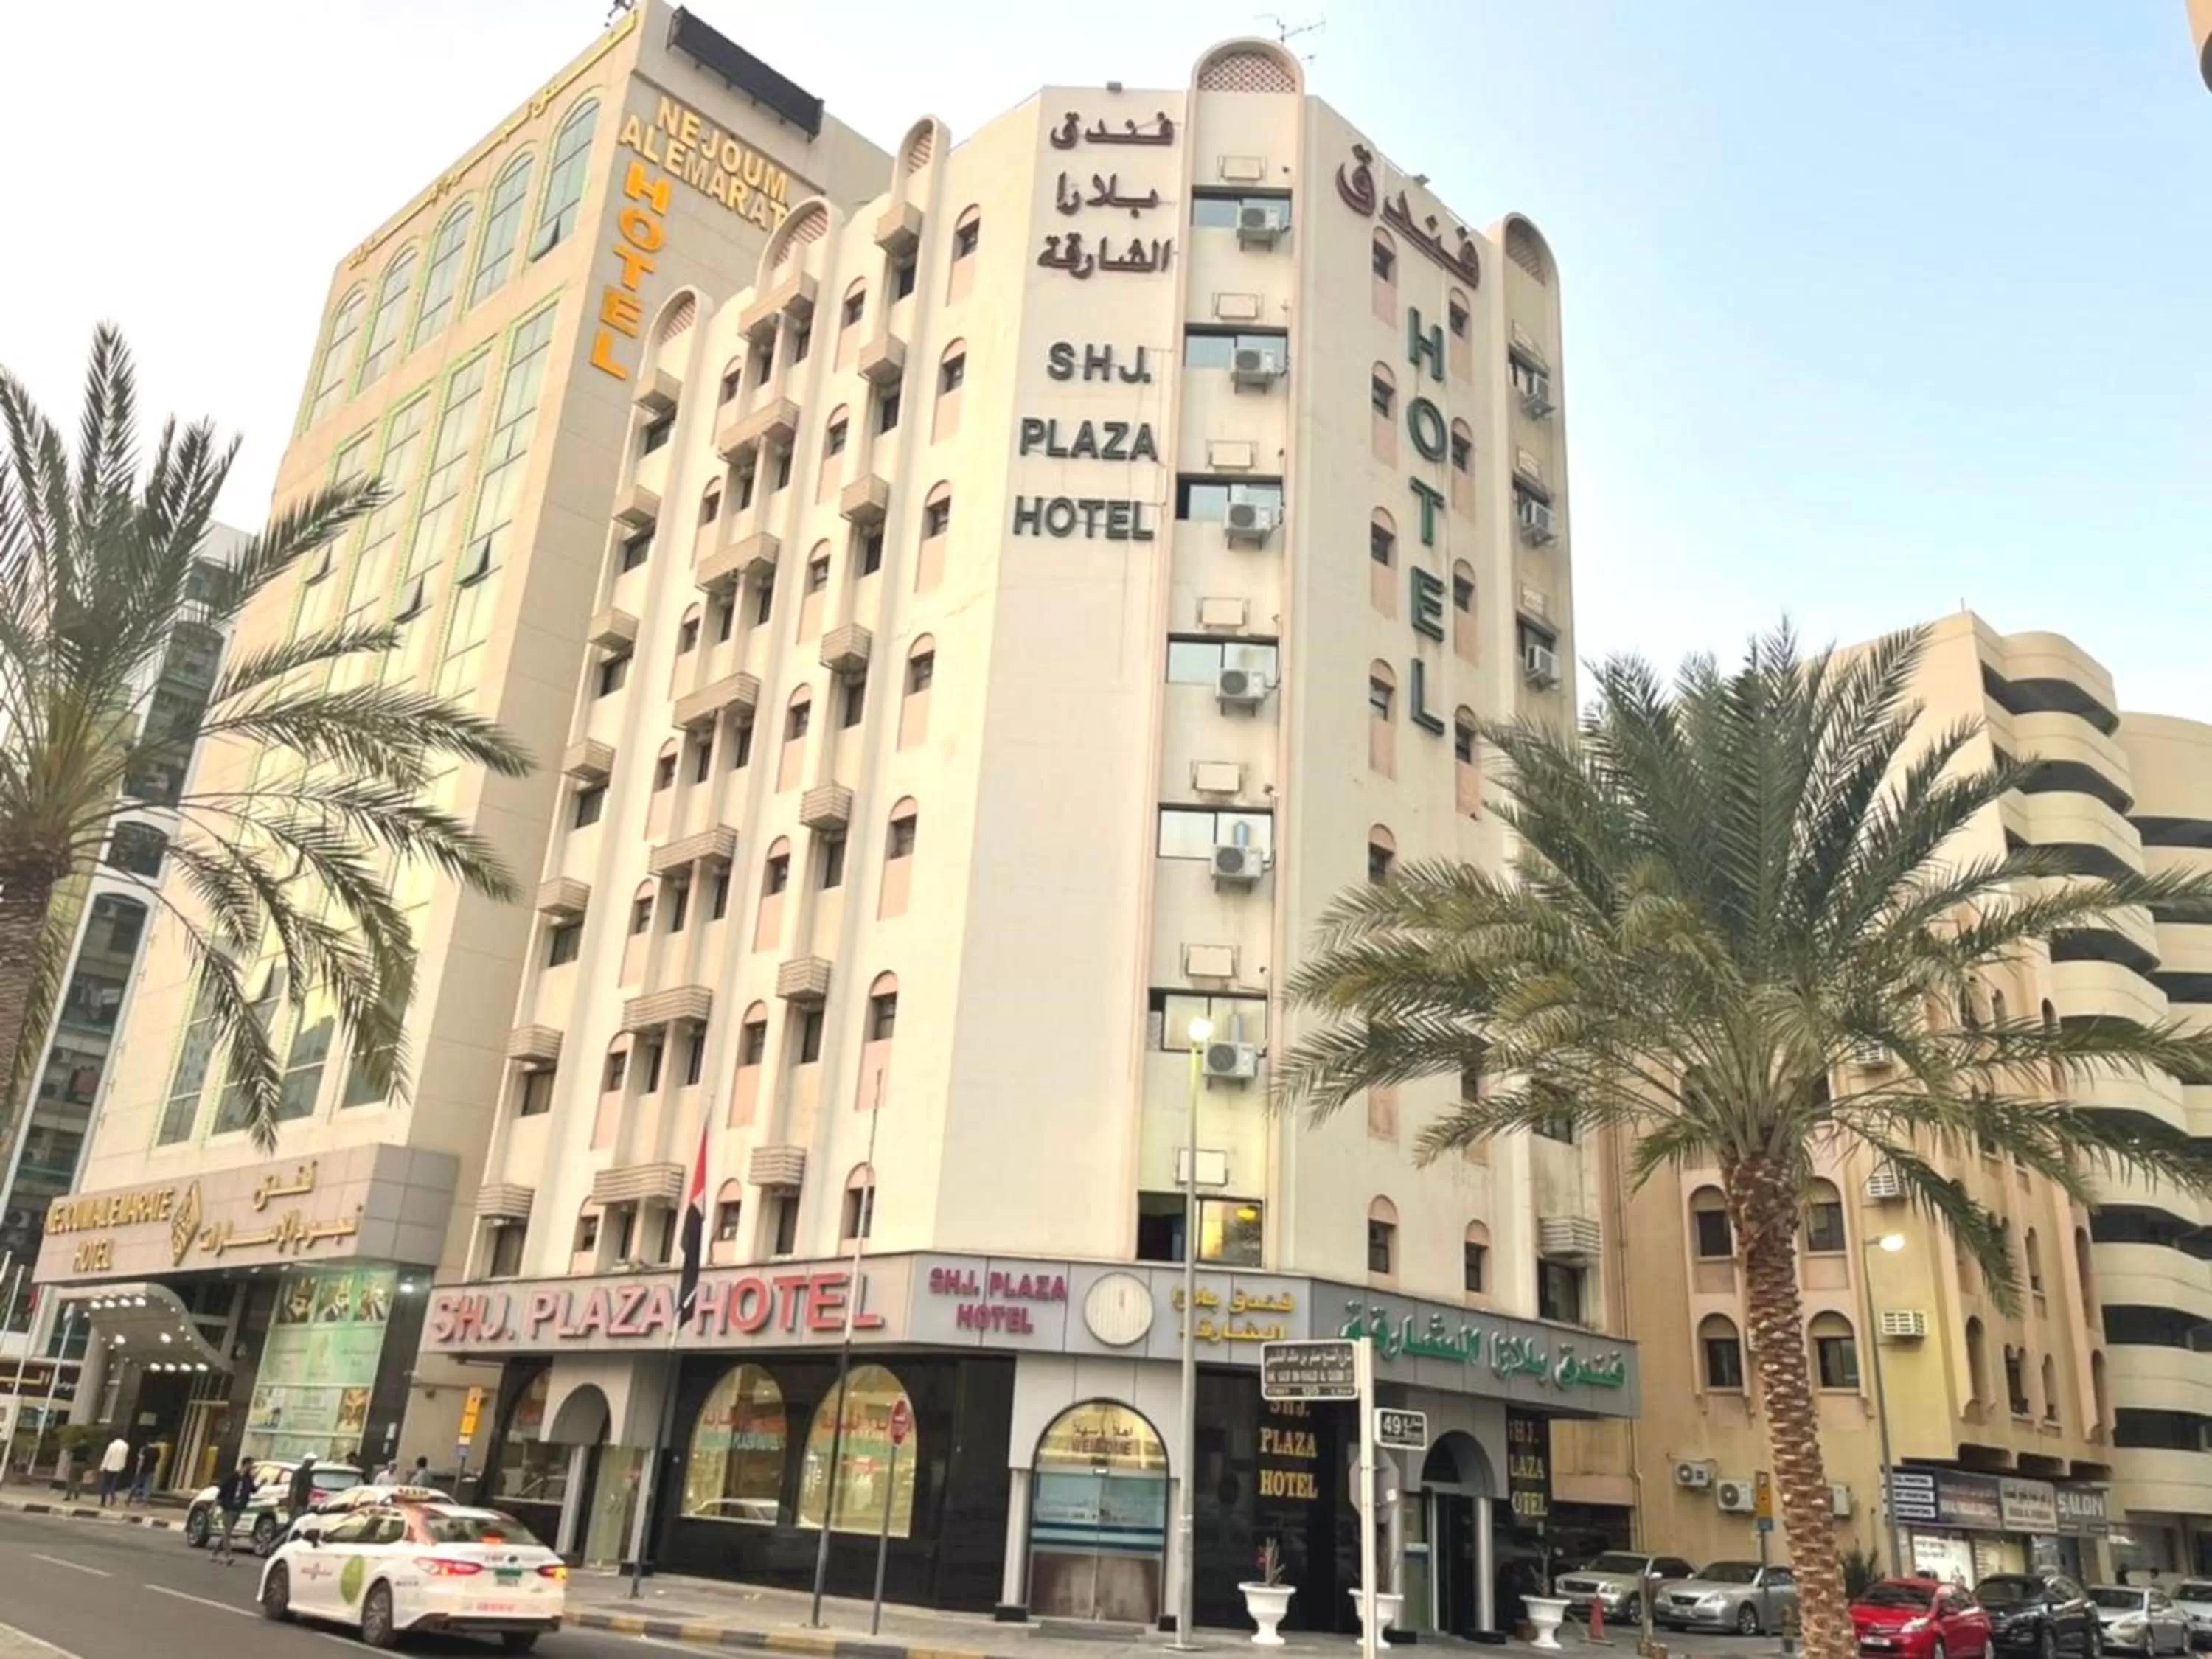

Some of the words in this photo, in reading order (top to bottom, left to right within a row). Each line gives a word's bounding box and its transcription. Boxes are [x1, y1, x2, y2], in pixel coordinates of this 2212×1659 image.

[655, 97, 790, 204] NEJOUM
[1049, 110, 1175, 150] فندق
[1335, 142, 1481, 290] فندق
[589, 160, 673, 380] HOTEL
[1037, 232, 1173, 279] الشارقة
[1047, 341, 1152, 385] SHJ.
[1019, 417, 1159, 462] PLAZA
[1012, 495, 1155, 541] HOTEL
[1405, 305, 1447, 738] HOTEL
[928, 1267, 981, 1298] SHJ.
[989, 1272, 1068, 1302] PLAZA
[1228, 1289, 1295, 1315] فندق
[431, 1292, 515, 1343] SHJ.
[530, 1281, 678, 1340] PLAZA
[691, 1271, 886, 1336] HOTEL
[956, 1304, 1034, 1336] HOTEL
[1338, 1298, 1481, 1363] الشارقة
[1553, 1343, 1626, 1391] فندق
[1259, 1427, 1318, 1458] PLAZA
[1382, 1415, 1402, 1436] 49
[1259, 1470, 1318, 1499] HOTEL
[1510, 1454, 1545, 1480] LAZA
[1511, 1490, 1548, 1517] OTEL
[2057, 1492, 2104, 1517] SALON
